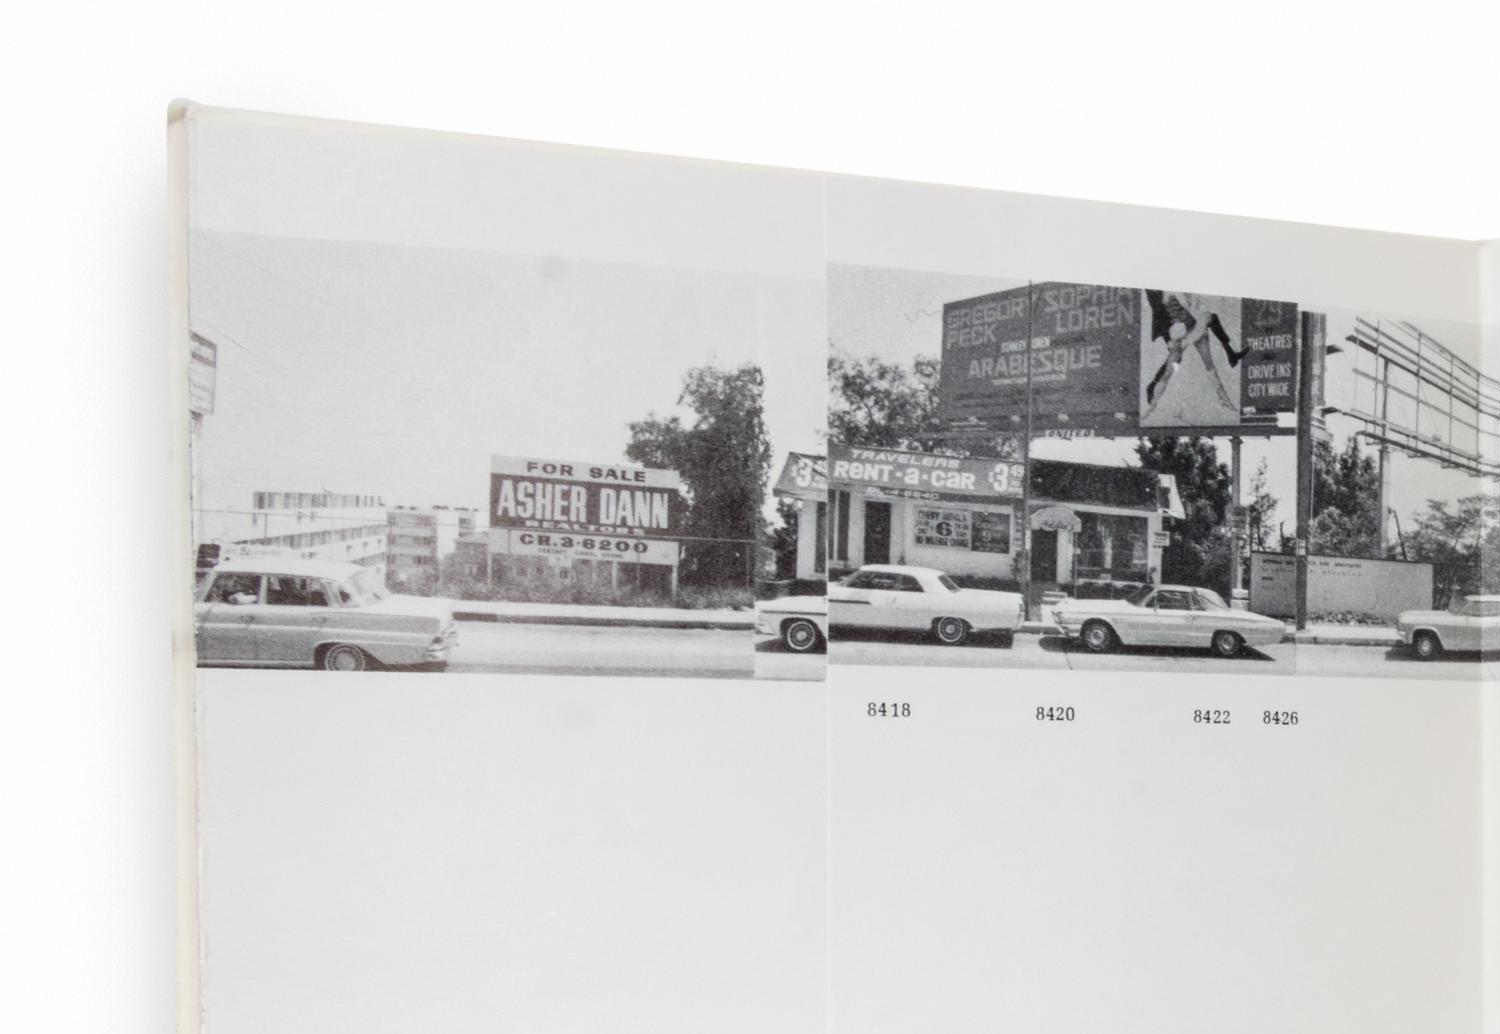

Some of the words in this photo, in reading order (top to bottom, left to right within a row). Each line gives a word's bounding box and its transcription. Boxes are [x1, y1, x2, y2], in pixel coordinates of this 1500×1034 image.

[1044, 285, 1135, 312] SOPHIA
[1056, 301, 1134, 333] LOREN
[946, 322, 997, 349] PECK
[1246, 334, 1292, 351] THEATRES
[1248, 364, 1275, 379] DRIVE
[850, 448, 960, 468] TRAVELERS
[526, 461, 574, 477] FOR
[590, 467, 647, 483] SALE
[497, 479, 588, 523] ASHER
[600, 487, 669, 529] DANN
[525, 520, 645, 536] REALTORS
[868, 701, 911, 718] 8418
[1035, 706, 1076, 722] 8420
[1193, 709, 1231, 725] 8422
[1262, 709, 1299, 726] 8426
